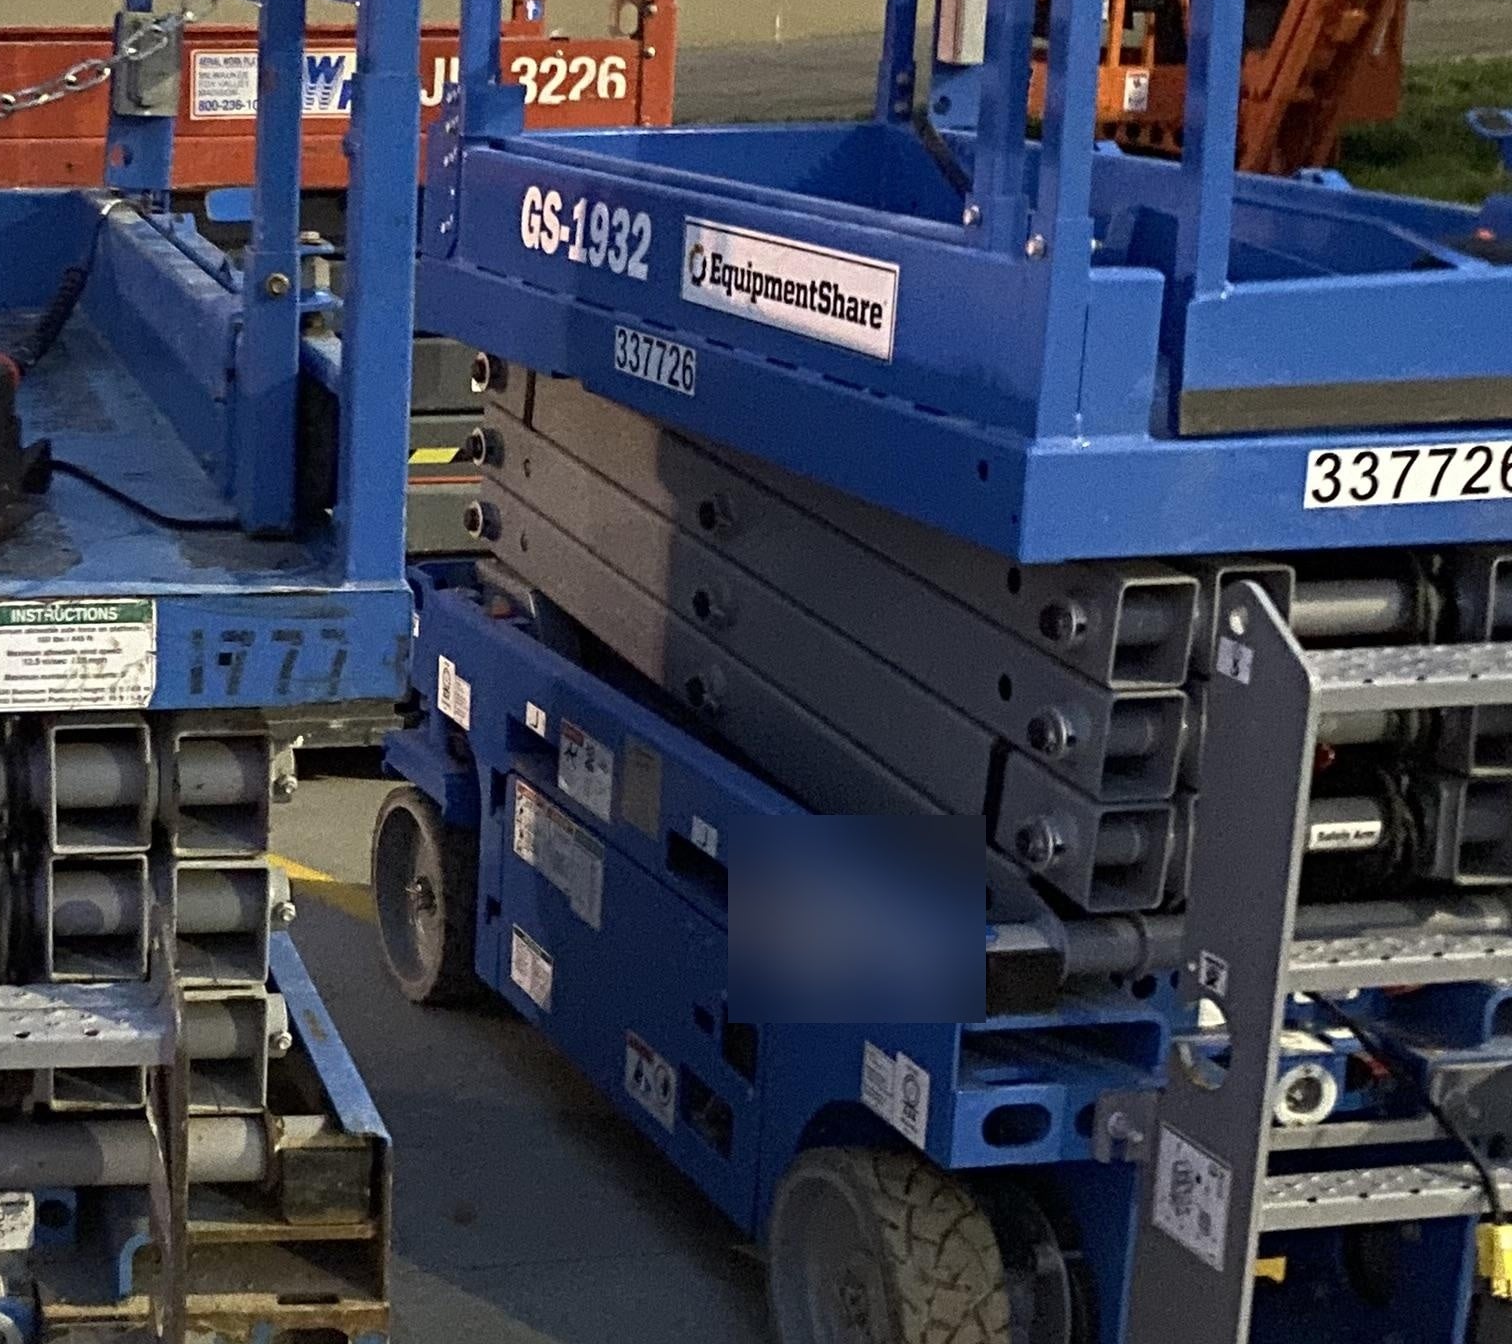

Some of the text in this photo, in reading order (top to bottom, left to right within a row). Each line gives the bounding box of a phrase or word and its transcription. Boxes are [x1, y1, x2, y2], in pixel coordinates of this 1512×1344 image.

[510, 56, 628, 105] 3226
[521, 185, 652, 281] GS-1932
[709, 252, 883, 330] EquipmentShare
[617, 328, 694, 391] 337726
[11, 607, 119, 623] INSTRUCTIONS
